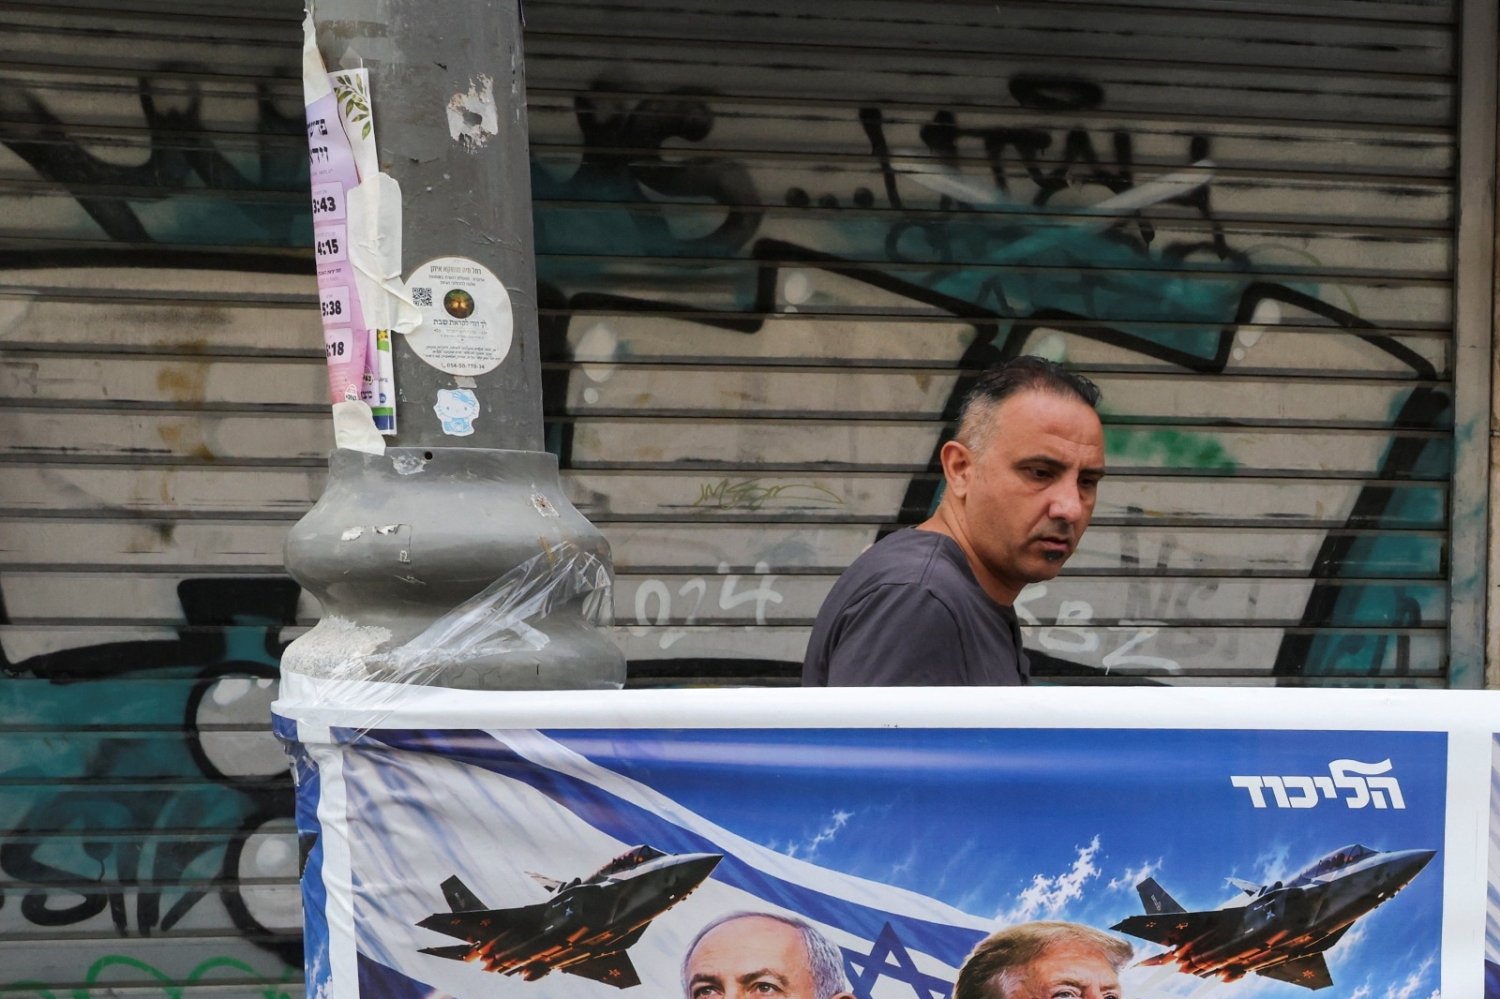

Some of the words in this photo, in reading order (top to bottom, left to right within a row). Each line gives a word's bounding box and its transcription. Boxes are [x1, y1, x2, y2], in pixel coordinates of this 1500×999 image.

[317, 239, 339, 256] 4:15
[322, 300, 342, 316] 5:38
[326, 341, 345, 357] :18
[1230, 758, 1406, 809] הליכוד
